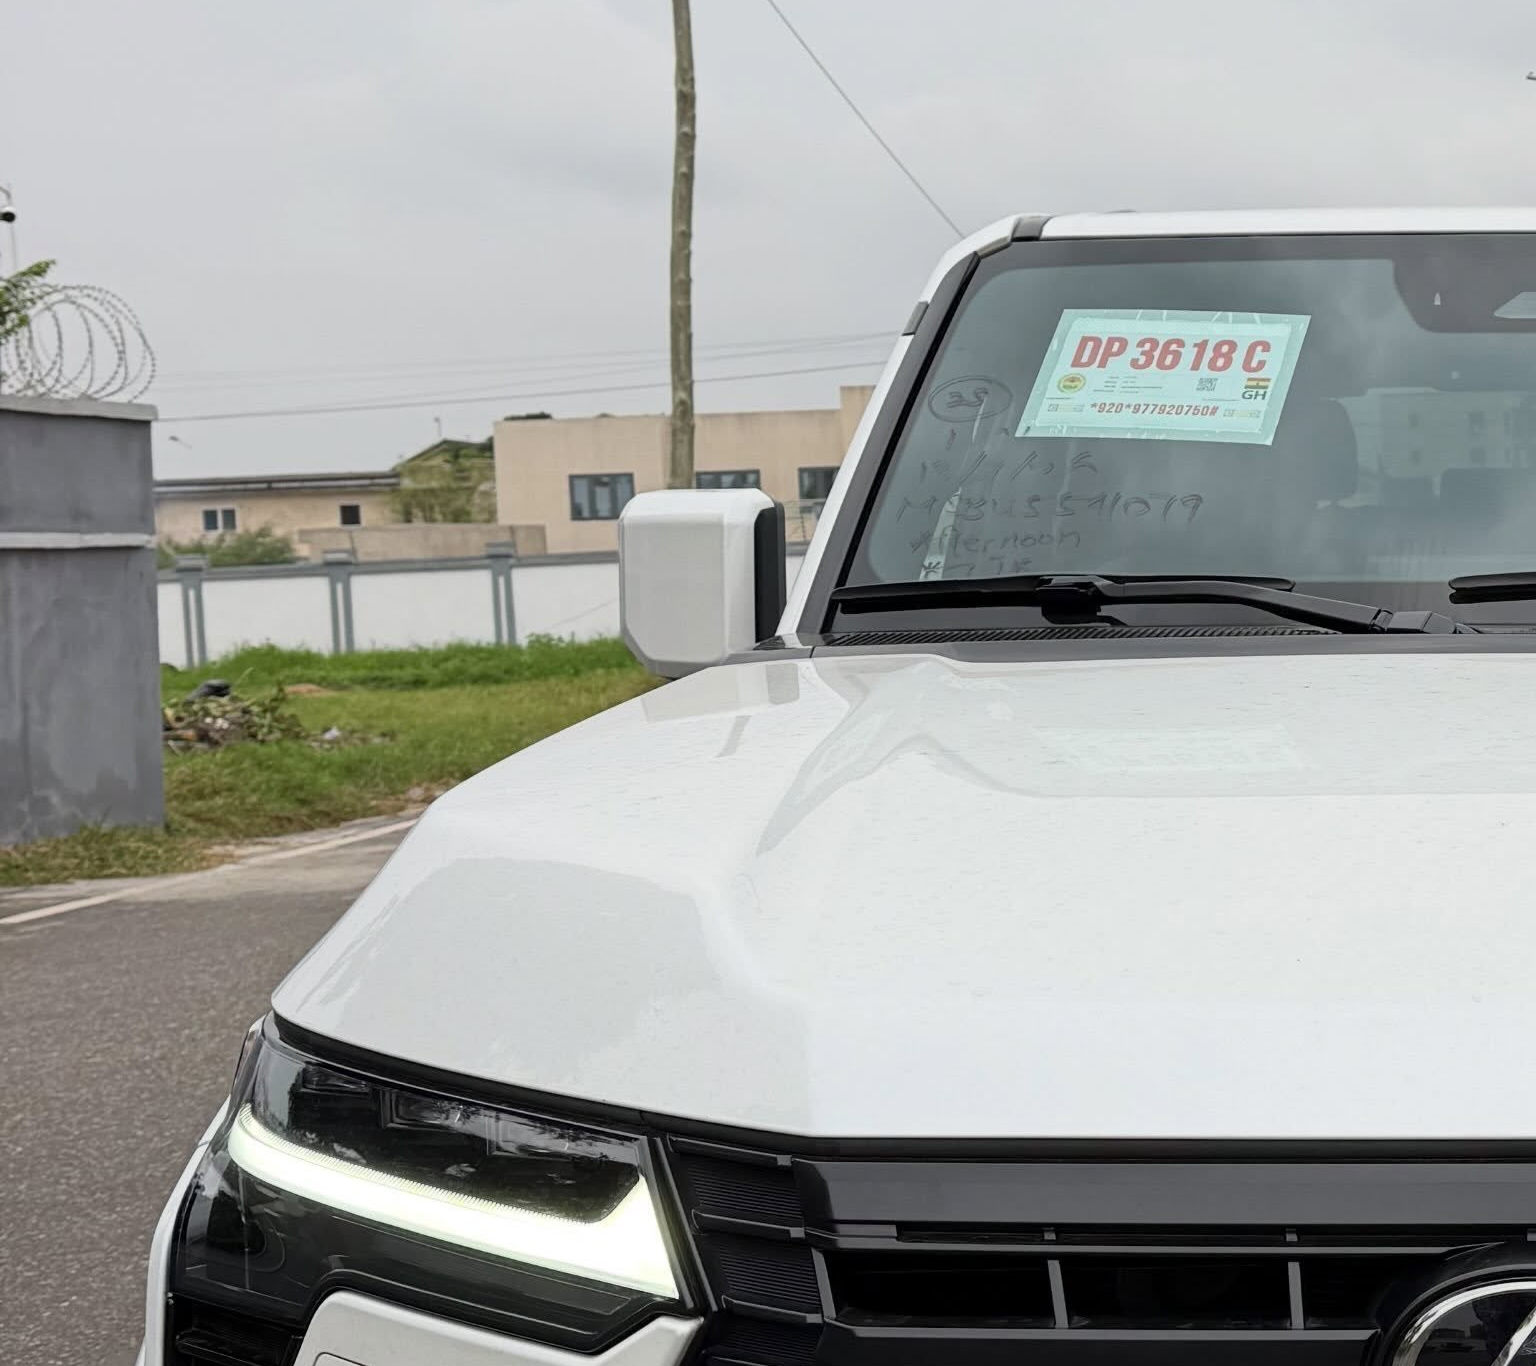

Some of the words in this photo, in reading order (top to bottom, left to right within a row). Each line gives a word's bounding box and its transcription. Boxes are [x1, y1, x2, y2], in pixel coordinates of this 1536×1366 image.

[1070, 335, 1129, 369] DP
[1130, 337, 1238, 373] 3618
[1241, 339, 1272, 374] C
[1241, 390, 1268, 402] GH
